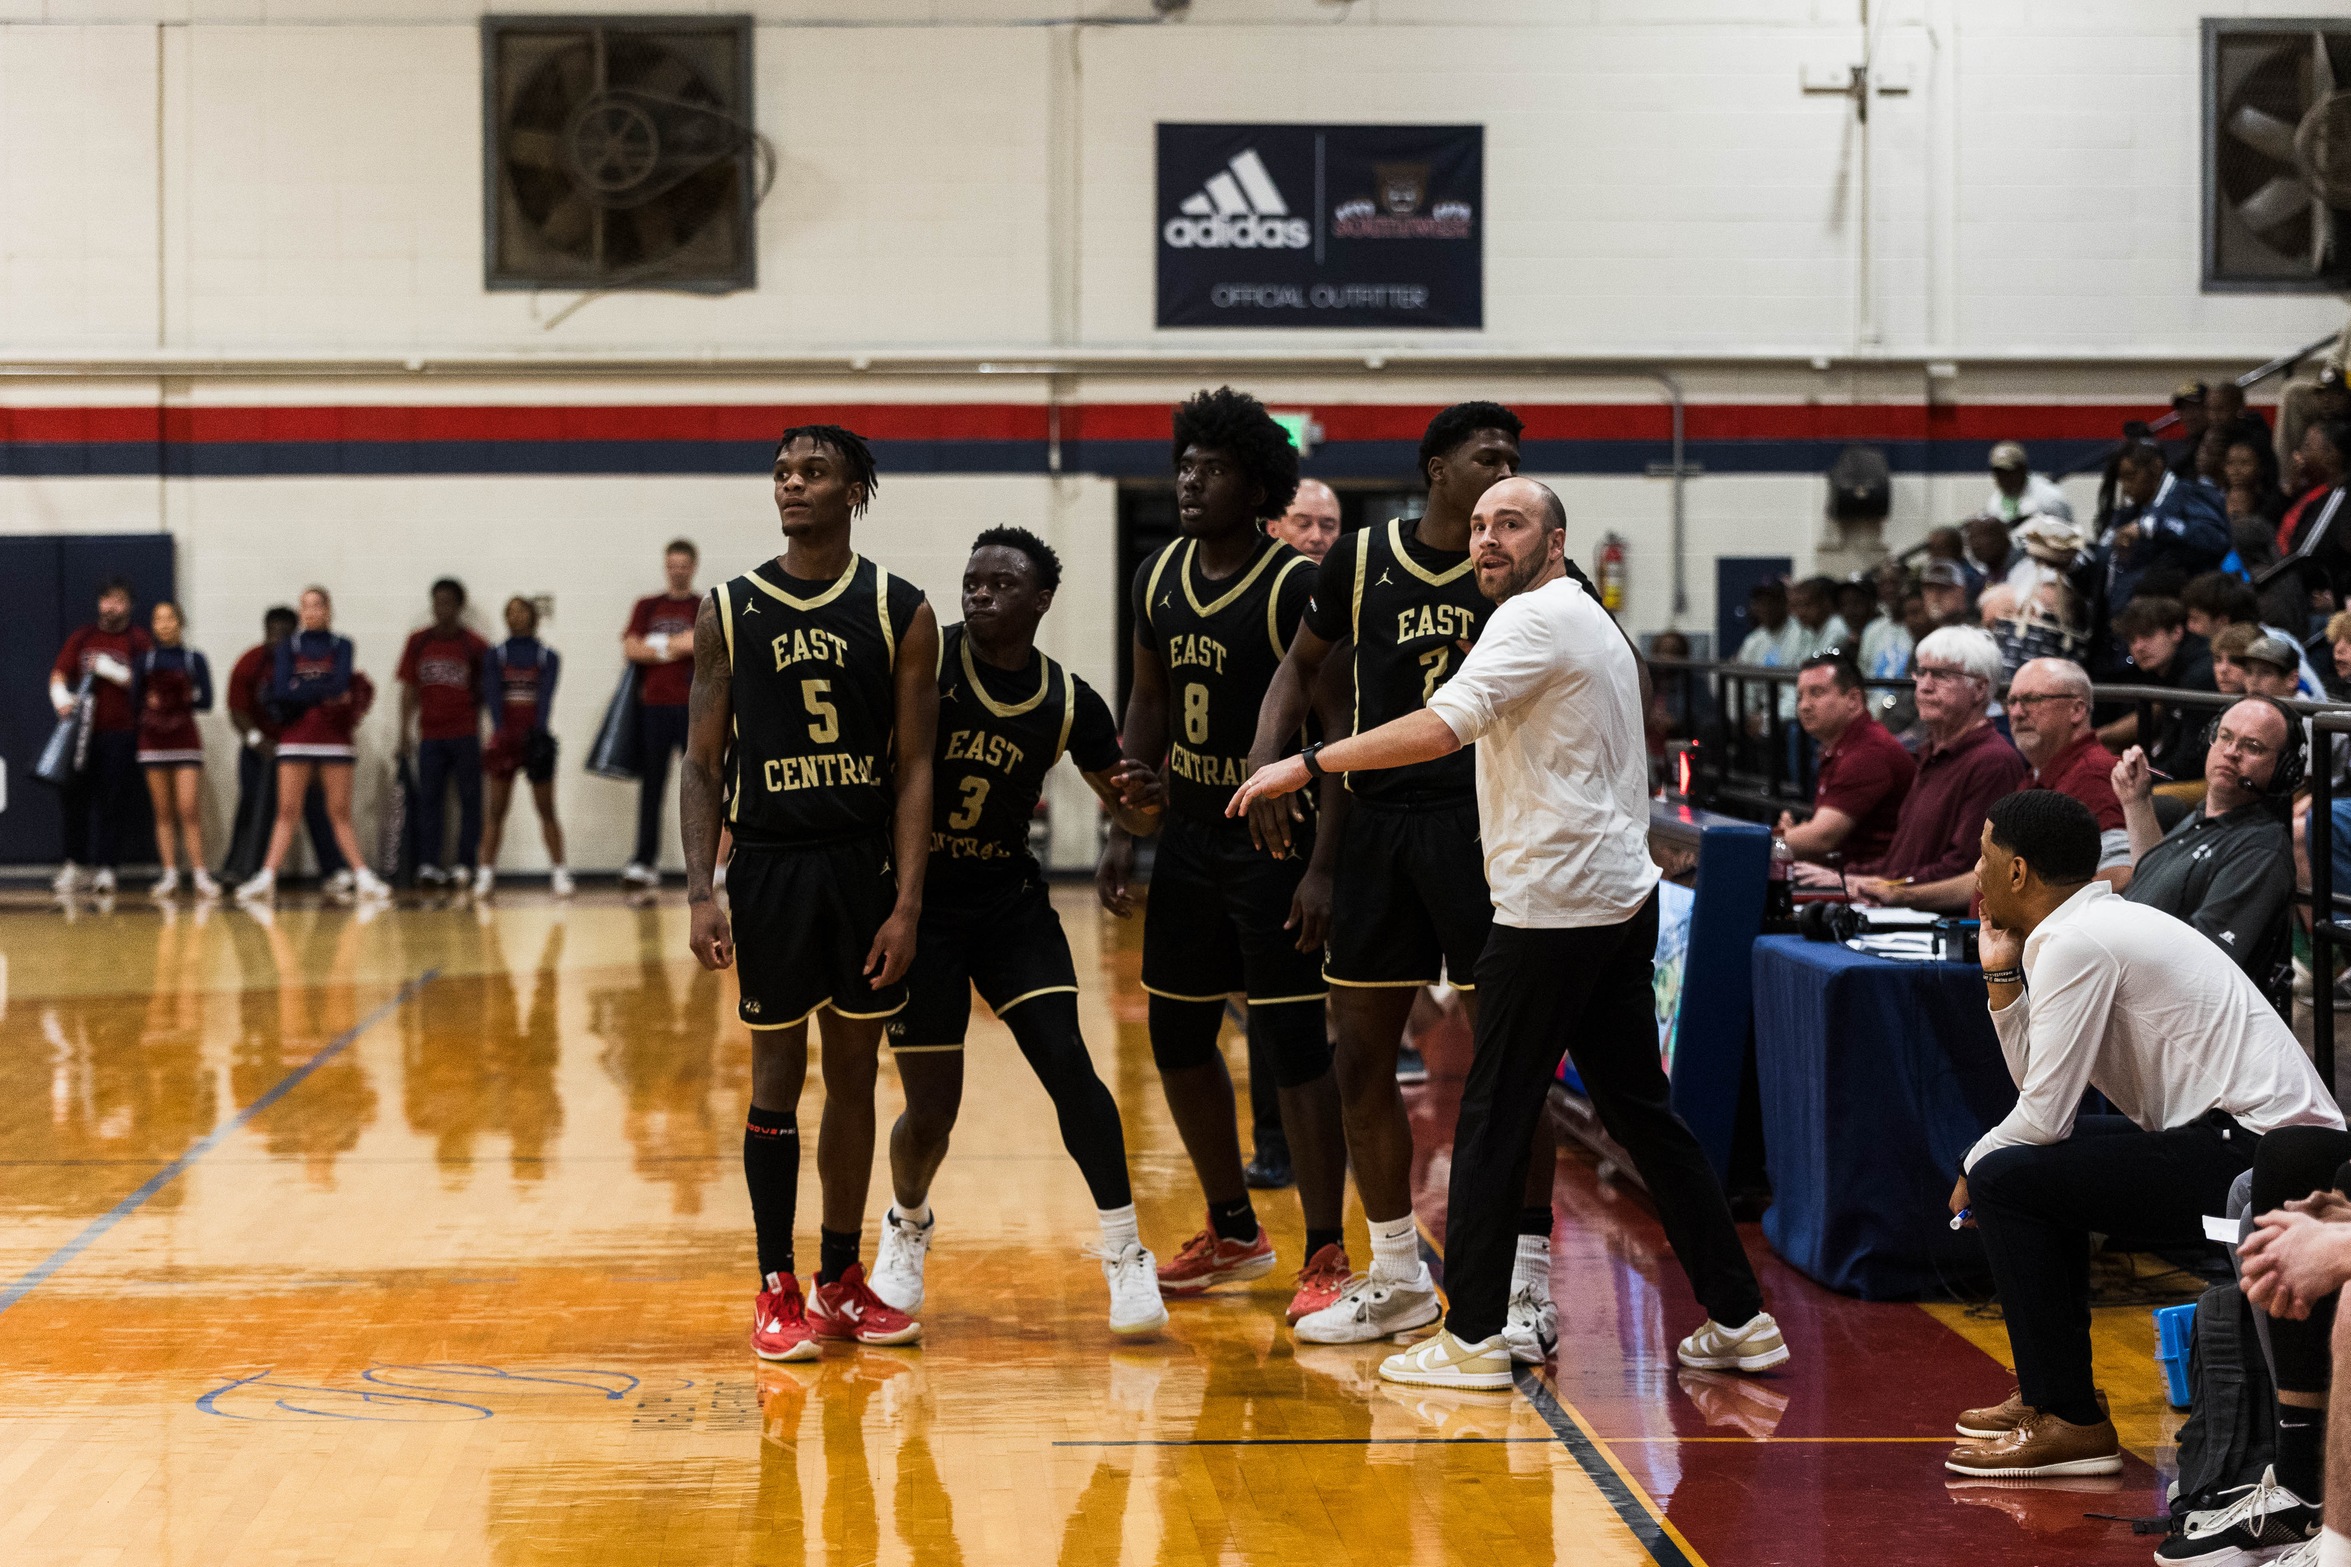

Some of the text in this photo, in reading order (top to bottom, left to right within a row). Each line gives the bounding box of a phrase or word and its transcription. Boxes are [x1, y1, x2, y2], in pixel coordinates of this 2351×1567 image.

[1164, 214, 1311, 248] adidas
[1397, 604, 1475, 645] EAST
[771, 628, 848, 673] EAST
[1170, 634, 1227, 675] EAST
[801, 679, 840, 744] 5
[1184, 682, 1209, 744] 8
[763, 753, 881, 793] CENTRAL
[944, 730, 1025, 775] EAST
[948, 775, 991, 830] 3
